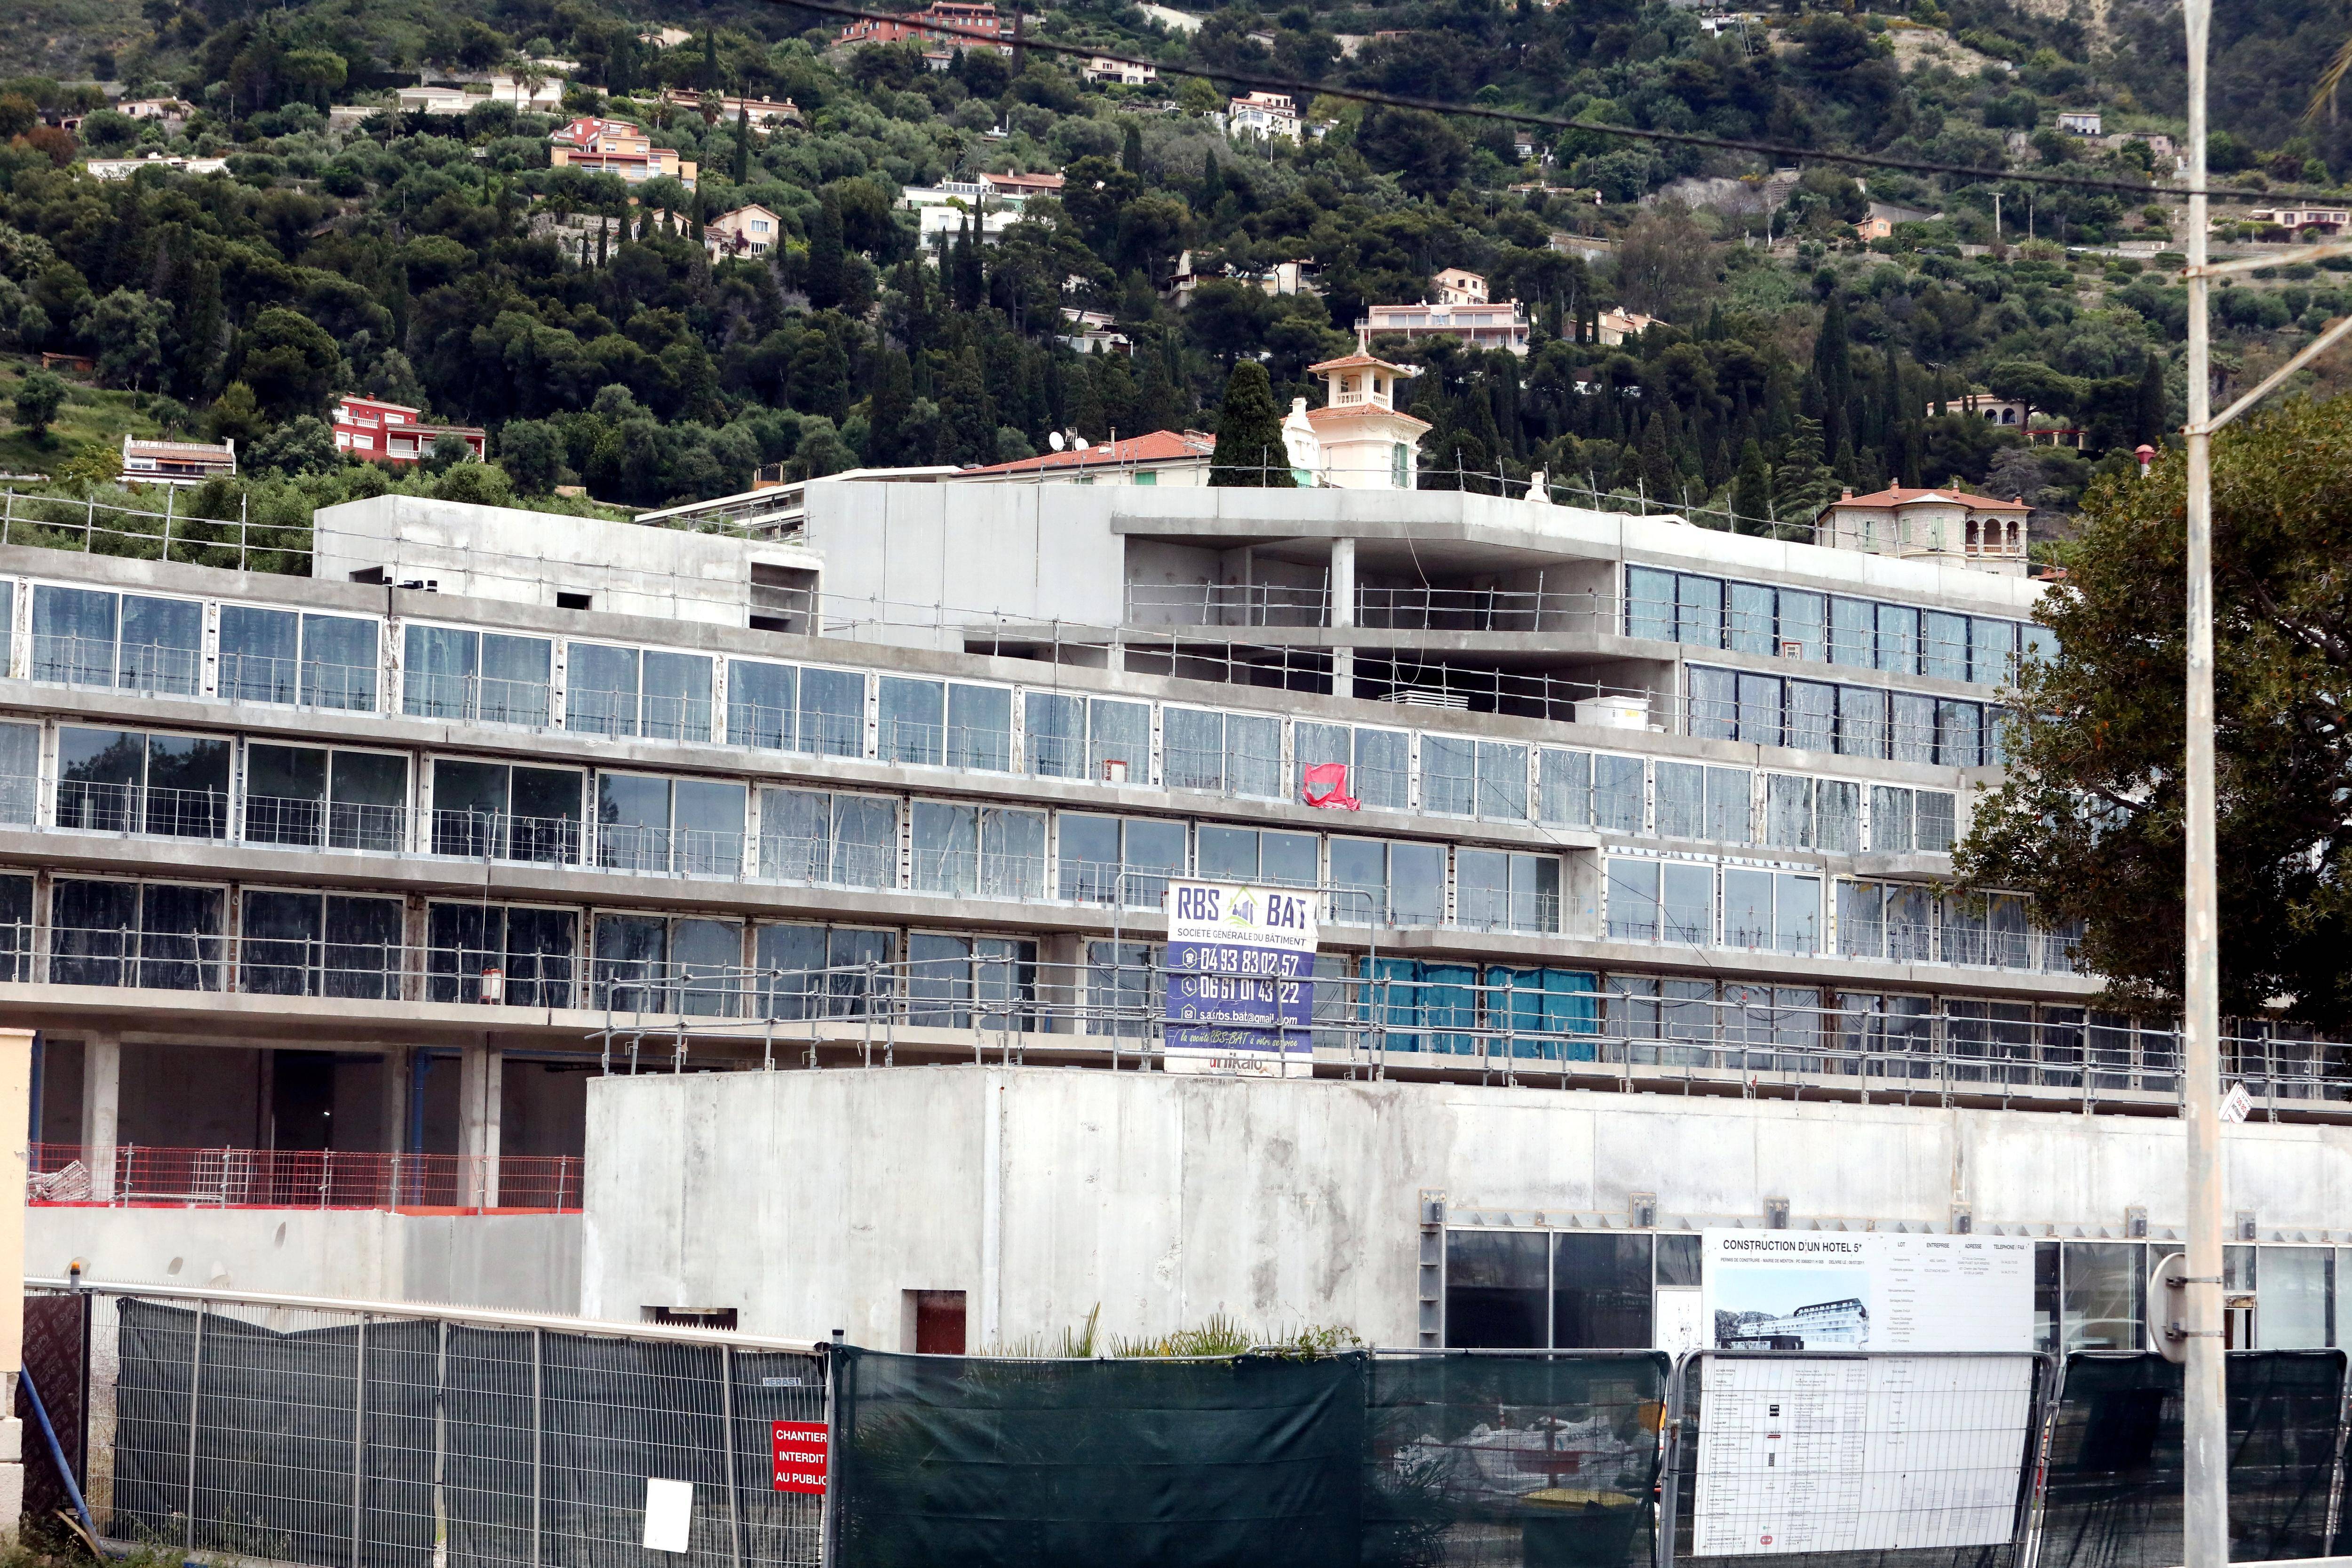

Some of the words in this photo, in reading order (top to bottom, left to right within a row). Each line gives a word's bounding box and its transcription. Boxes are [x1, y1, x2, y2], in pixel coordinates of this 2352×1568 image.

[1177, 887, 1220, 921] RBS
[1266, 894, 1306, 930] BAT
[1177, 928, 1211, 938] SOCIÉTÉ
[1213, 929, 1252, 941] GÉNÉRALE
[1265, 933, 1307, 947] BÂTIMENT
[1200, 947, 1218, 970] 04
[1221, 949, 1238, 972] 93
[1241, 950, 1259, 973] 83
[1261, 952, 1278, 974] 02
[1281, 954, 1299, 977] 57
[1200, 976, 1218, 998] 06
[1221, 978, 1235, 999] 61
[1240, 979, 1255, 1001] 01
[1258, 980, 1273, 1003] 43
[1280, 981, 1300, 1004] 22
[1180, 1029, 1187, 1042] la
[1272, 1037, 1298, 1047] sevice
[1723, 1240, 1796, 1251] CONSTRUCTION
[1798, 1242, 1820, 1251] D'UN
[1823, 1242, 1851, 1252] HOTEL
[776, 1430, 827, 1443] CHANTIER
[779, 1451, 825, 1464] INTERDIT
[776, 1472, 790, 1482] AU
[792, 1473, 826, 1486] PUBLIC
